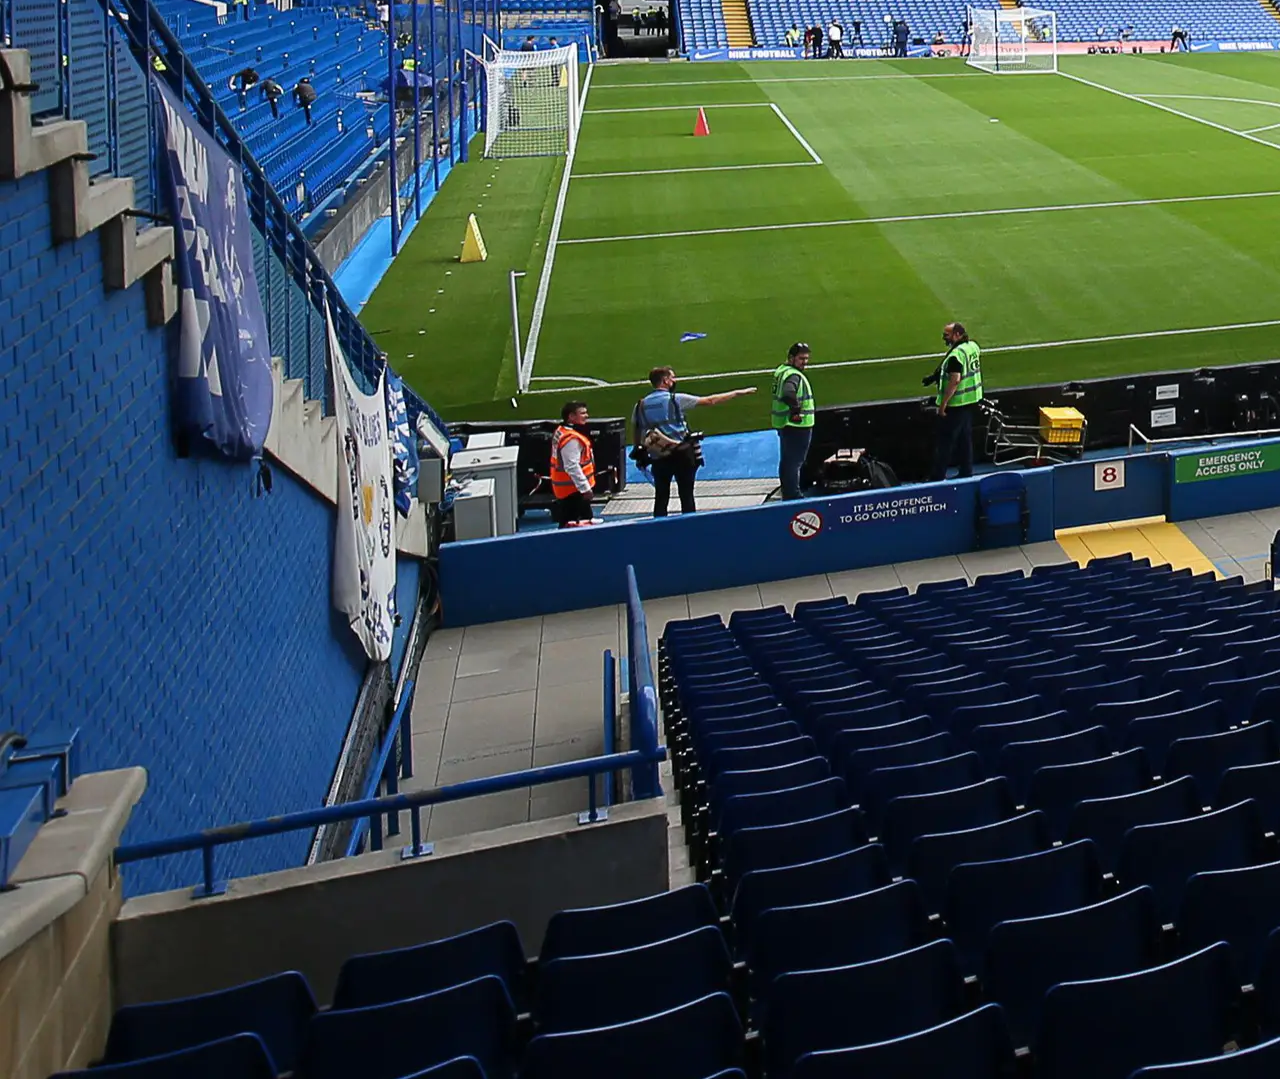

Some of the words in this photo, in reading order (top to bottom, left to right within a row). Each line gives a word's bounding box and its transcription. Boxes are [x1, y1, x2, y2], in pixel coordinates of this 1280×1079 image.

[728, 49, 750, 59] NIKE
[752, 49, 797, 58] FOOTBALL
[1199, 451, 1262, 467] EMERGENCY
[1102, 467, 1117, 482] 8
[1195, 463, 1236, 477] ACCESS
[1238, 460, 1265, 472] ONLY
[853, 505, 864, 513] IT
[876, 502, 890, 510] AN
[891, 496, 933, 508] OFFENCE
[840, 515, 852, 523] TO
[855, 513, 870, 522] GO
[872, 510, 898, 520] ONTO
[901, 507, 917, 516] THE
[919, 503, 947, 514] PITCH
